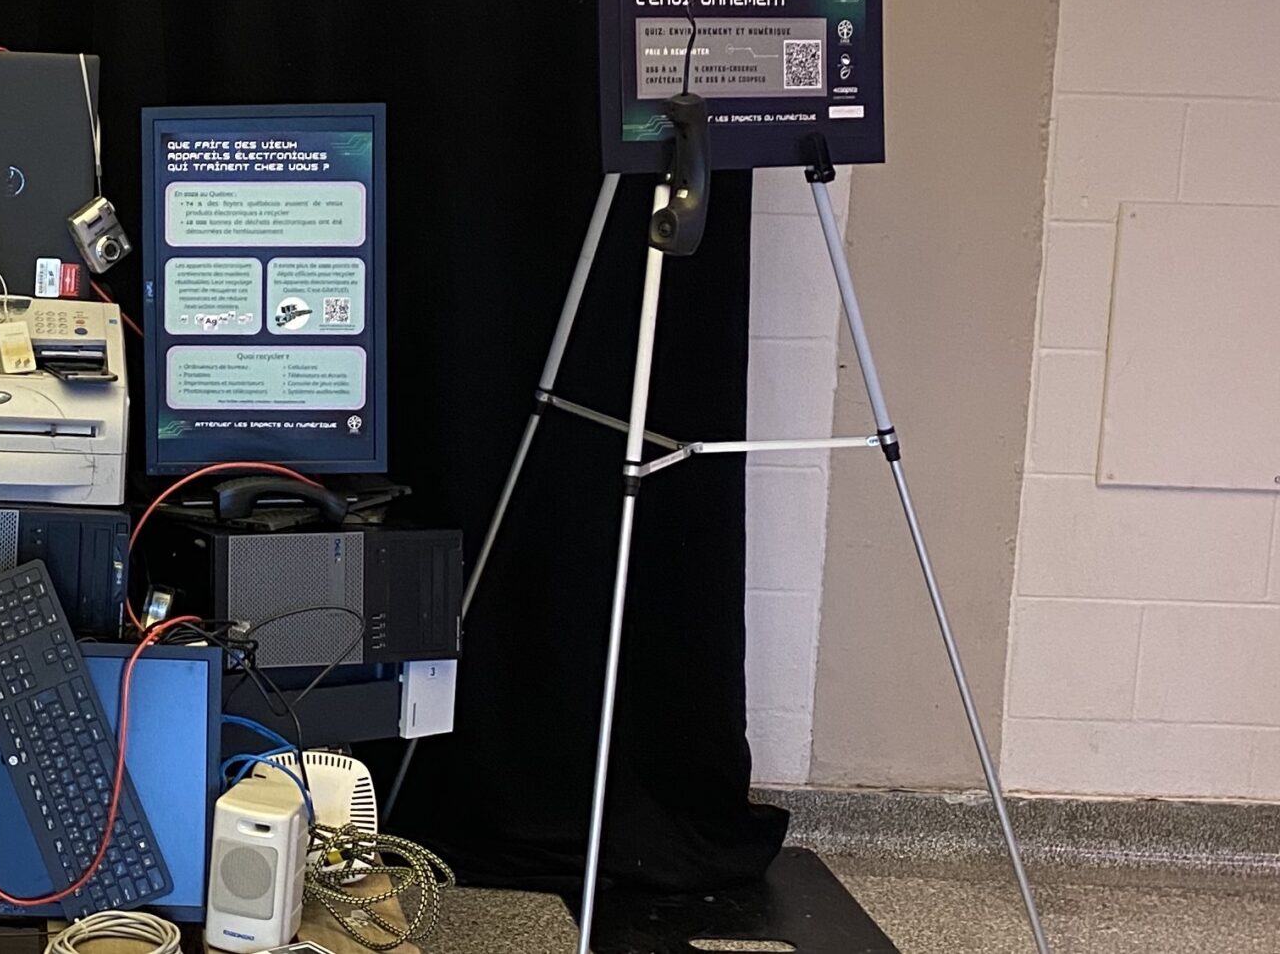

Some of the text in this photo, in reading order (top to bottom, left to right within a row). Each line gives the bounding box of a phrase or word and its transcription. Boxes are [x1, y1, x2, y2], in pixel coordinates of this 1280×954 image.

[670, 27, 732, 36] ENVIRNNEMENT
[736, 27, 744, 35] ET
[670, 48, 710, 56] REMPRTER
[167, 139, 298, 150] QUE FAIRE DES VIEUX
[167, 150, 231, 161] APPAREILS
[167, 161, 189, 172] QUI
[254, 162, 284, 172] CHEZ
[288, 162, 319, 172] VOUS
